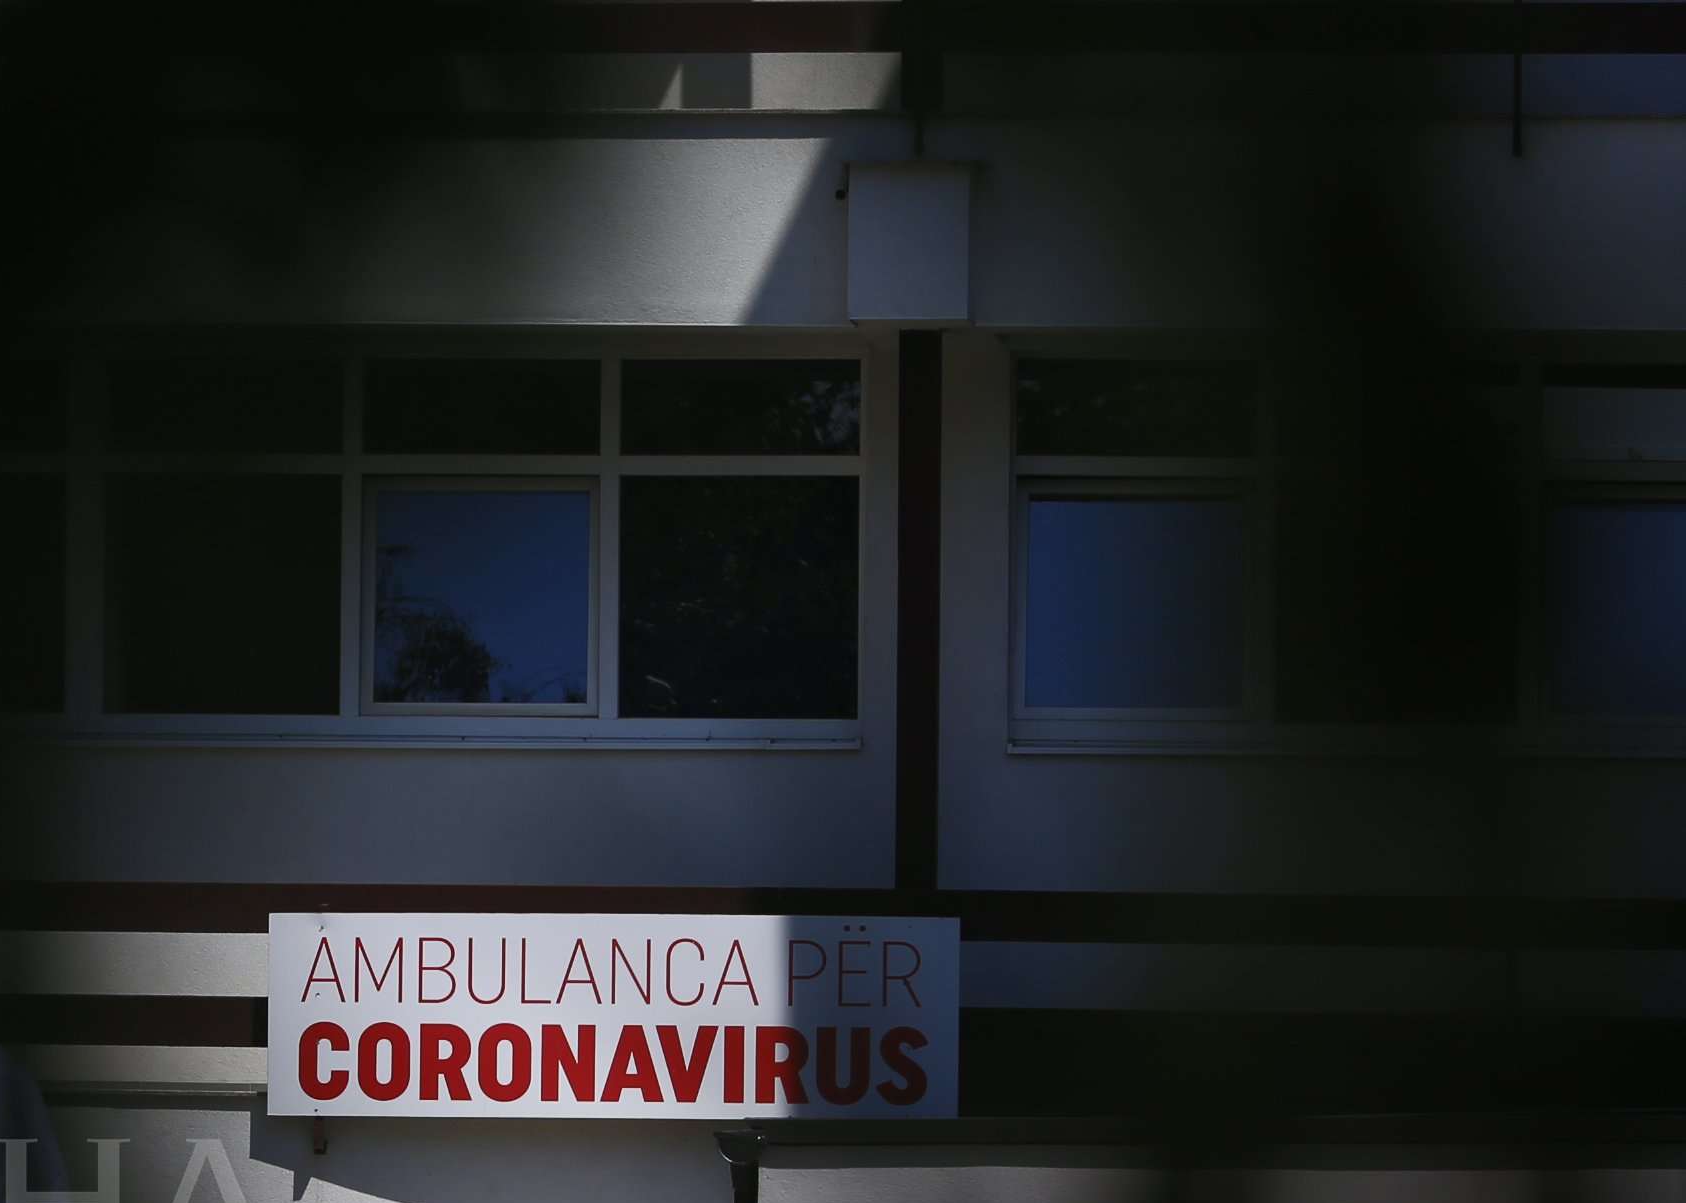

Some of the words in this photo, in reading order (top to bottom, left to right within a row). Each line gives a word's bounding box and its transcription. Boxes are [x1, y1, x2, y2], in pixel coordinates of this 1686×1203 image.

[298, 934, 760, 1007] AMBULANCA
[786, 924, 924, 1009] PËR
[297, 1020, 929, 1106] CORONAVIRUS
